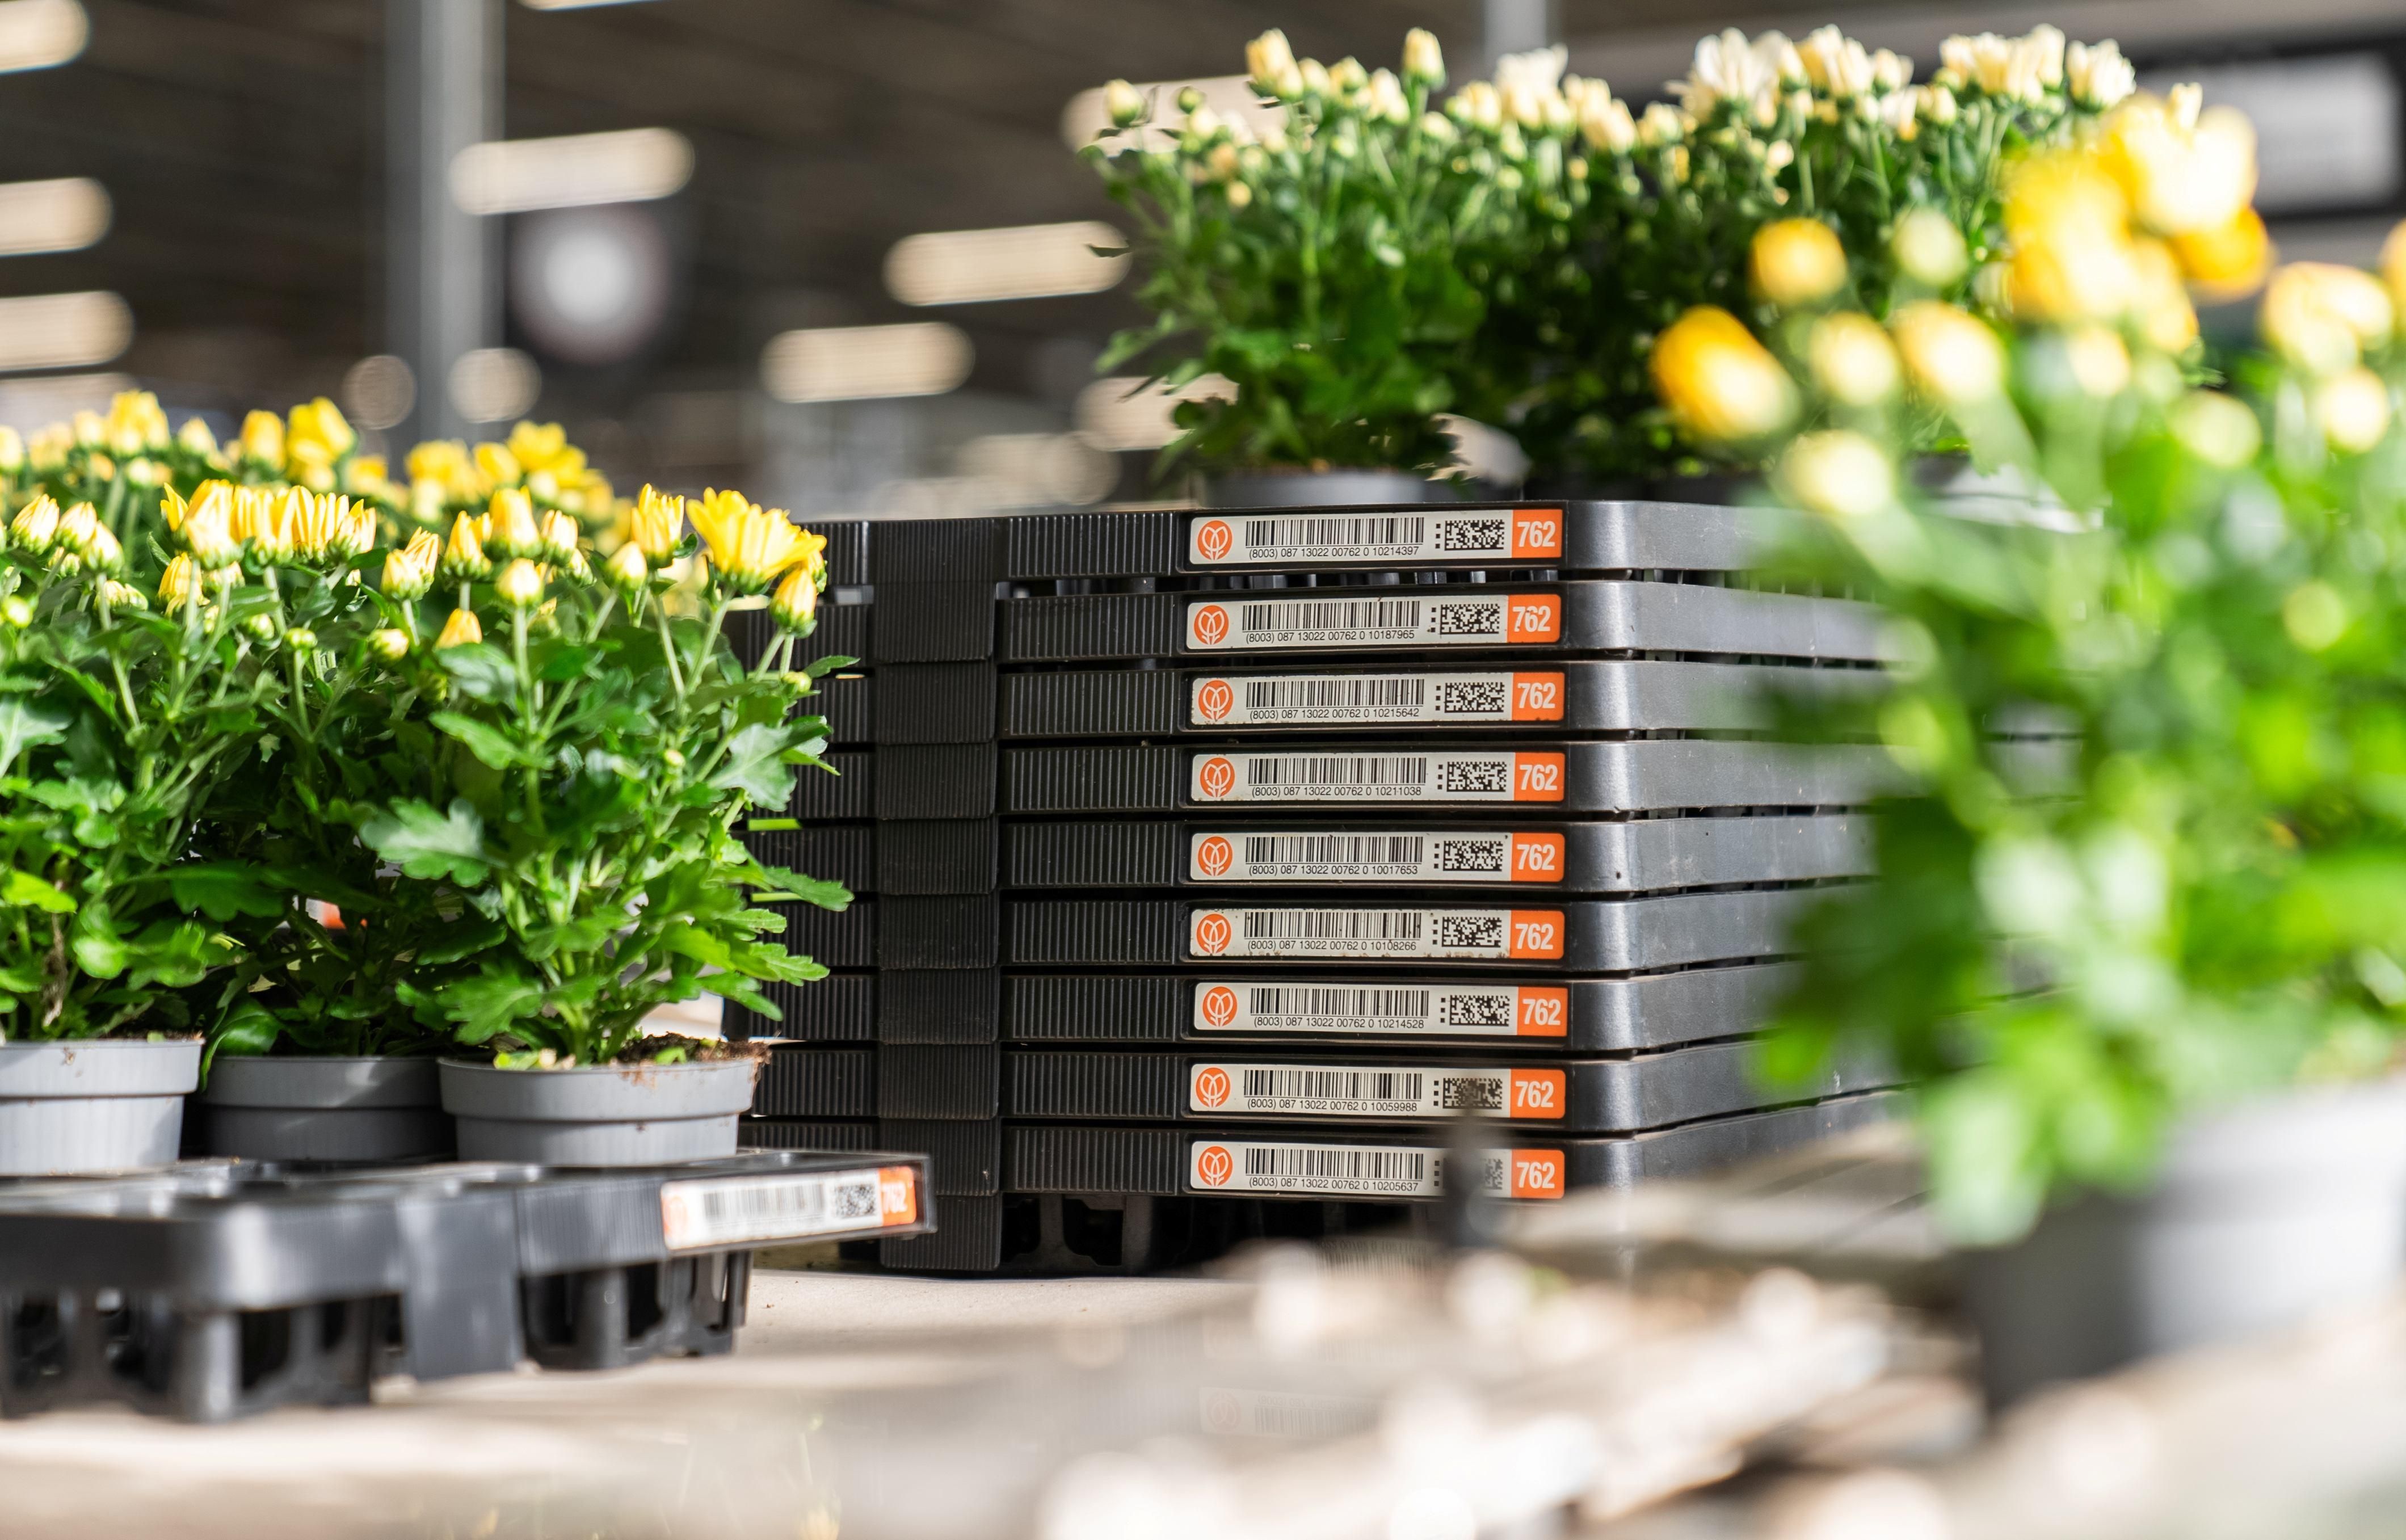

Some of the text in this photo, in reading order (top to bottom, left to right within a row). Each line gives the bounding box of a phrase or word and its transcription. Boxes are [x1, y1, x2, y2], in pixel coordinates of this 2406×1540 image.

[1517, 521, 1555, 548] 762
[1249, 546, 1419, 560] (8003) 087 13022 00762 0 10214397
[1512, 605, 1551, 632] 762
[1246, 630, 1415, 643] (8003) 087 13022 00762 0 10187965
[1517, 682, 1556, 709] 762
[1250, 708, 1419, 721] (8003) 087 13022 00762 0 10215642
[1520, 764, 1558, 791] 762
[1252, 786, 1421, 798] (8003) 087 13022 00762 0 10211038
[1517, 844, 1555, 870] 762
[1249, 865, 1418, 877] (8003) 087 13022 00762 0 10017653
[1248, 940, 1416, 953] (8003) 087 13022 00762 0 10108266
[1515, 923, 1554, 950] 762
[1522, 998, 1561, 1025] 762
[1254, 1017, 1424, 1029] (8003) 087 13022 00762 0 10214528
[1515, 1081, 1554, 1108] 762
[1247, 1099, 1417, 1112] (8003) 087 13022 00762 0 10059988
[1249, 1177, 1419, 1191] (8003) 087 13022 00762 0 10205637
[1516, 1162, 1555, 1189] 762
